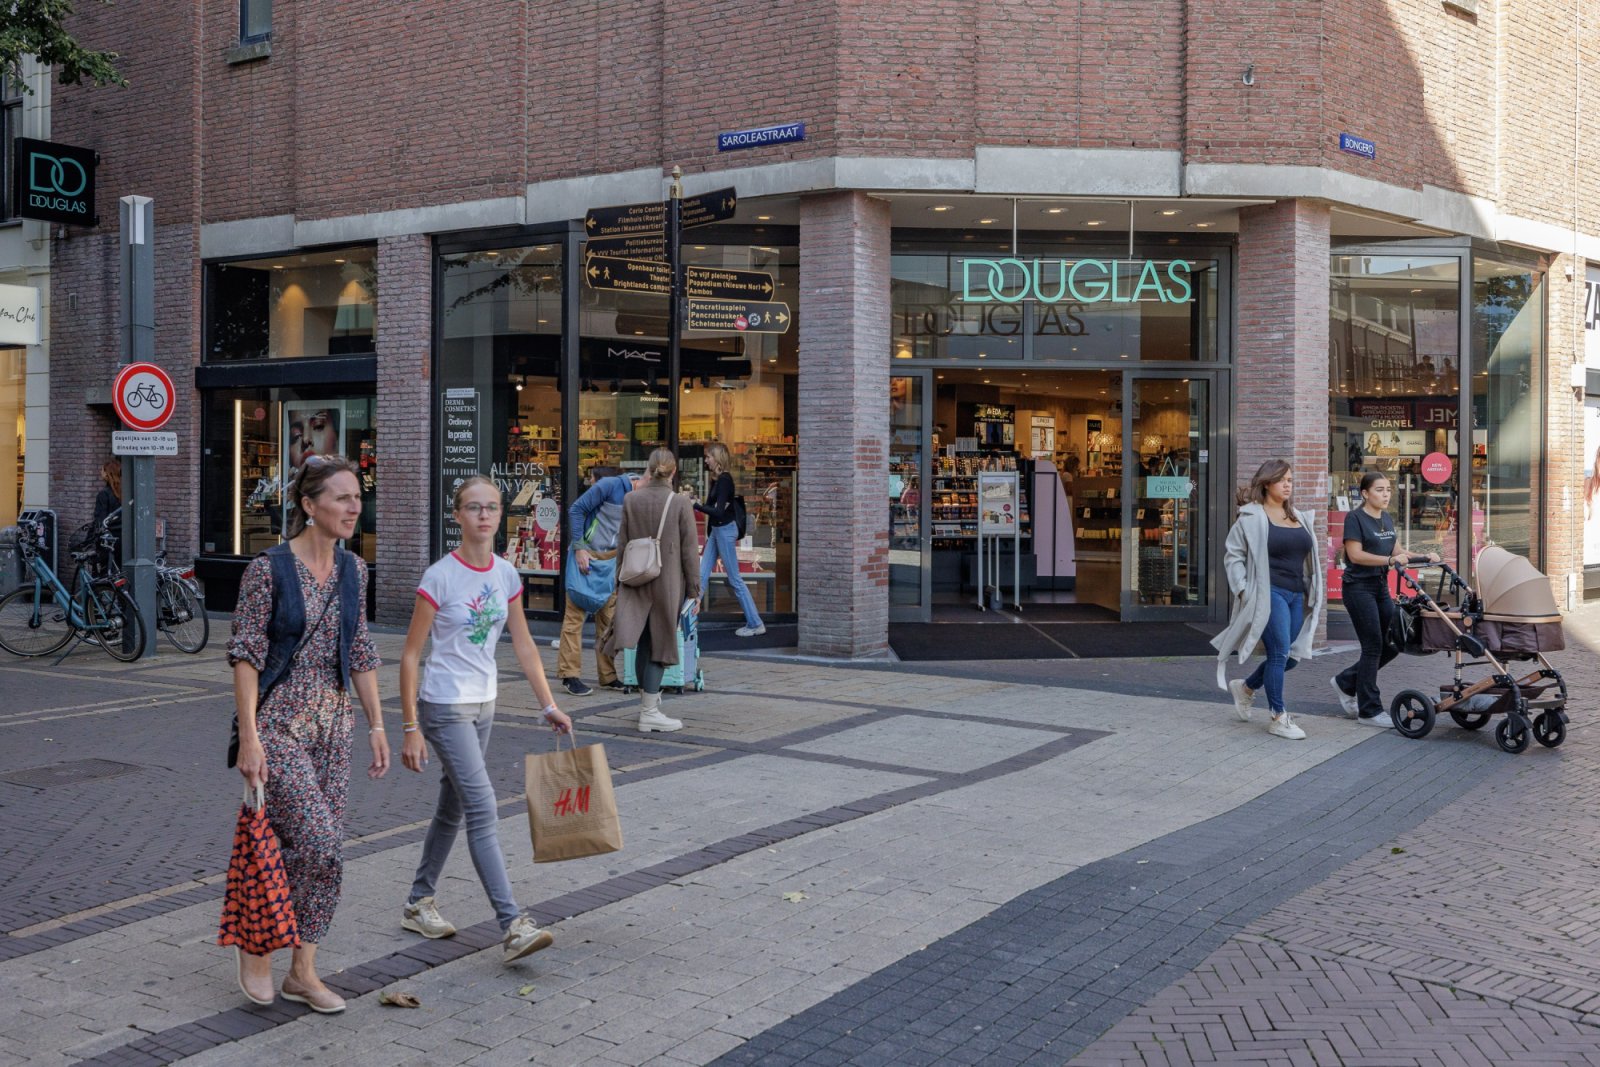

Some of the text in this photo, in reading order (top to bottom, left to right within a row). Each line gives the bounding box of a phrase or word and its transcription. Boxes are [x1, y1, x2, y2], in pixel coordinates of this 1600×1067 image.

[722, 126, 799, 147] SAROLEASTRAAT
[29, 194, 87, 214] DOUGLAS
[627, 263, 655, 272] Openbaar
[711, 273, 737, 281] pleintjes
[963, 258, 1192, 303] DOUGLAS
[613, 279, 649, 289] Brightlands
[723, 282, 747, 290] (Nieuwe
[691, 303, 746, 312] Pancratiusplein
[1370, 419, 1413, 428] CHANEL
[454, 430, 472, 441] prairie
[490, 462, 544, 476] ALL EYES
[537, 507, 557, 517] -20%
[553, 784, 591, 817] H&M
